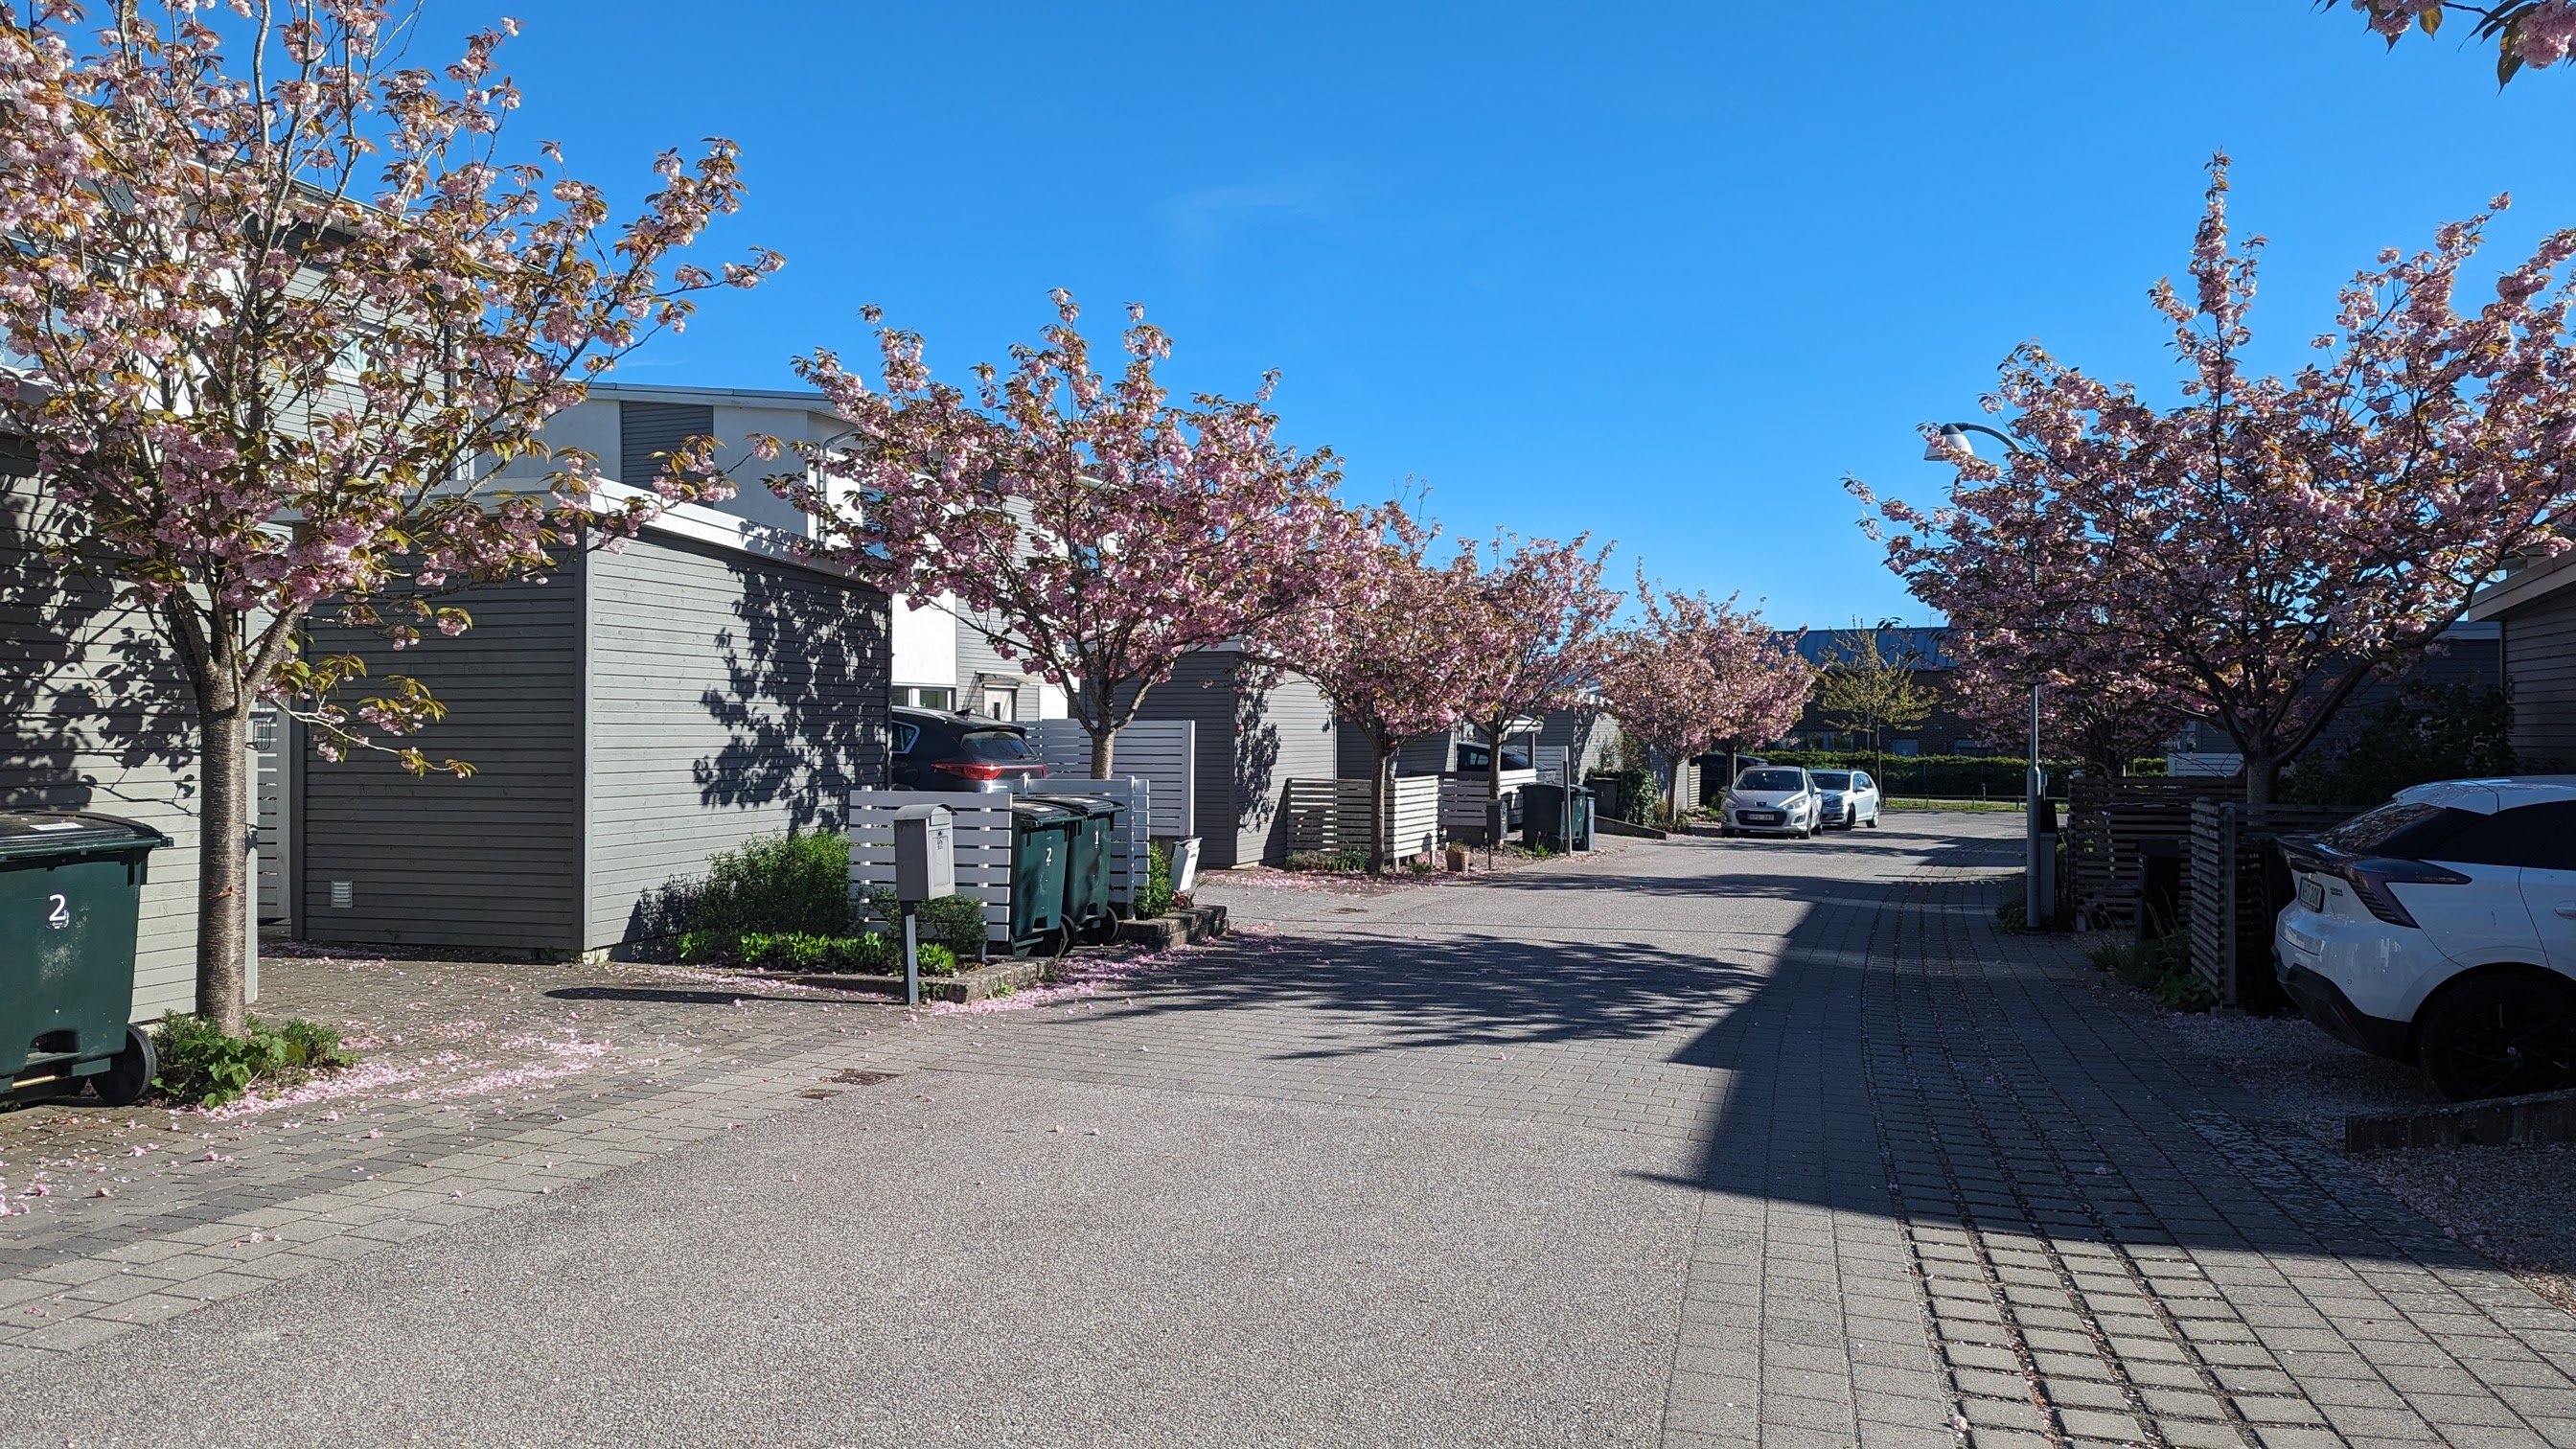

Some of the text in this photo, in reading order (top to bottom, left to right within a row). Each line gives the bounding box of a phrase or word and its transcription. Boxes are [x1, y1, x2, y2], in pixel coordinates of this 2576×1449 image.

[1094, 830, 1099, 844] 1
[1046, 847, 1052, 862] 2
[49, 893, 66, 921] 2
